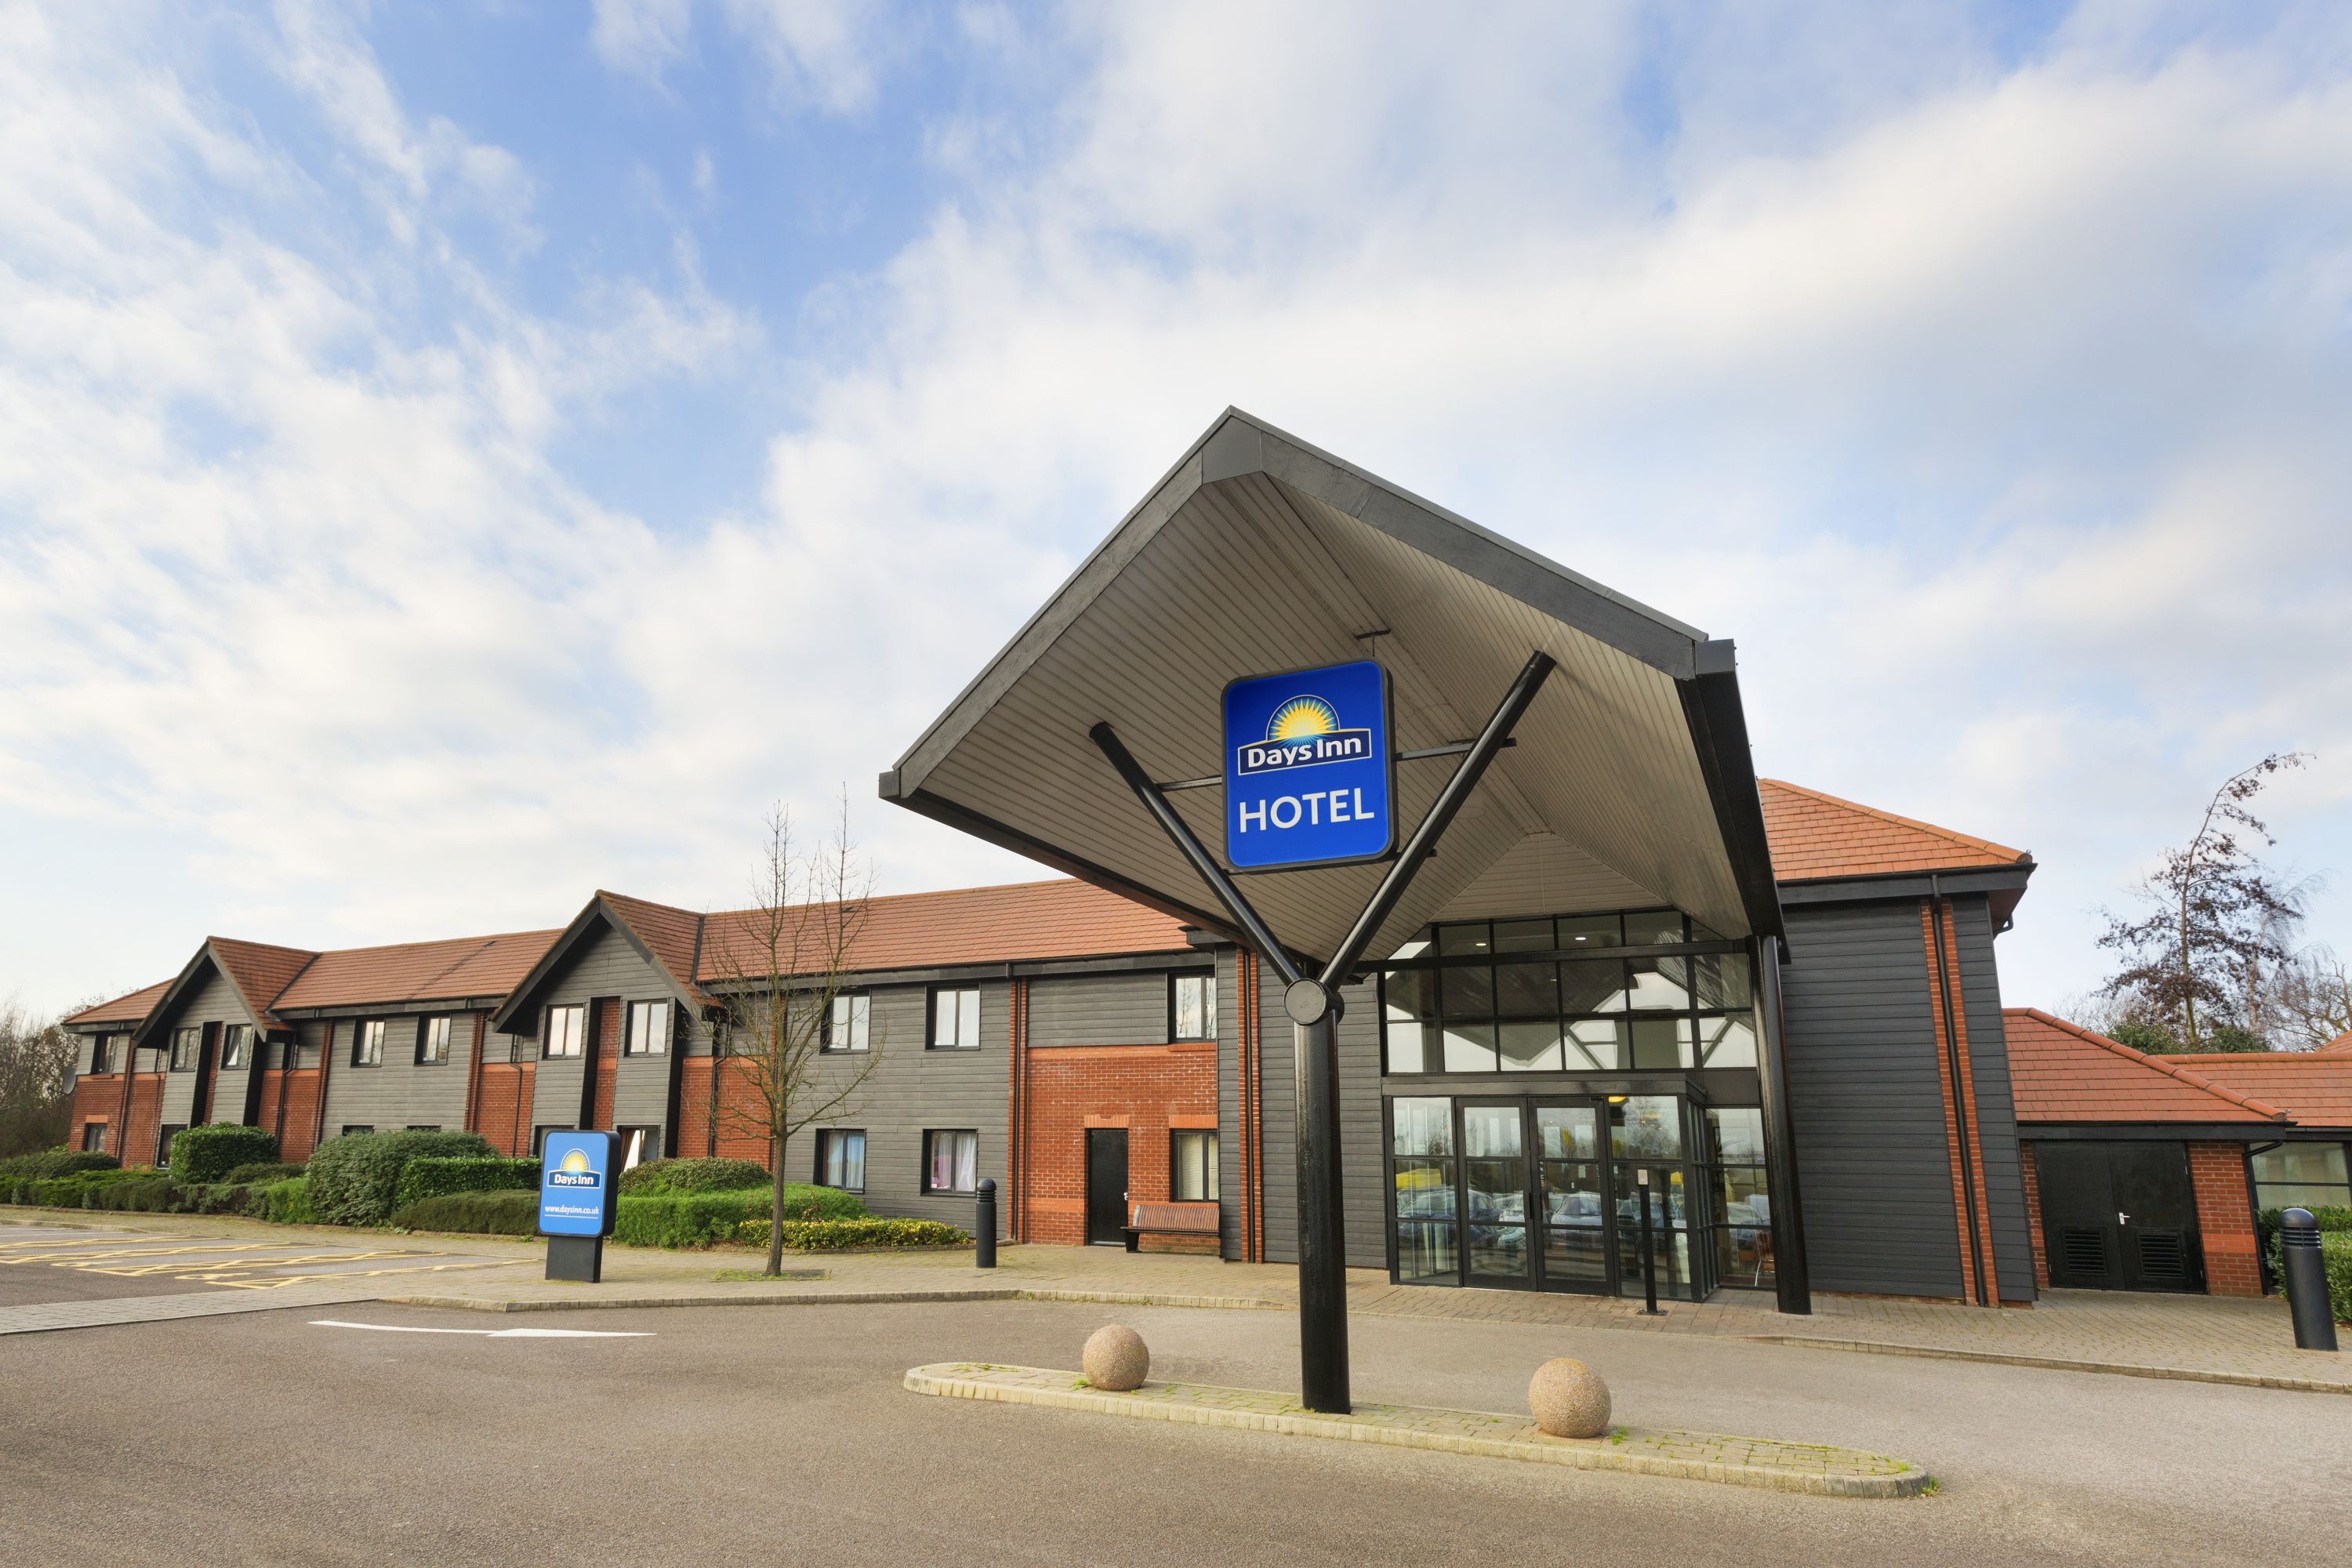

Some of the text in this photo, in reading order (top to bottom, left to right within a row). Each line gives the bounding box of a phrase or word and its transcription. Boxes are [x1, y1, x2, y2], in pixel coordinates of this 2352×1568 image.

[1247, 737, 1361, 768] Days Inn
[1240, 787, 1374, 833] HOTEL
[554, 1174, 593, 1185] Days Inn
[545, 1204, 599, 1214] www.daysinn.co.uk
